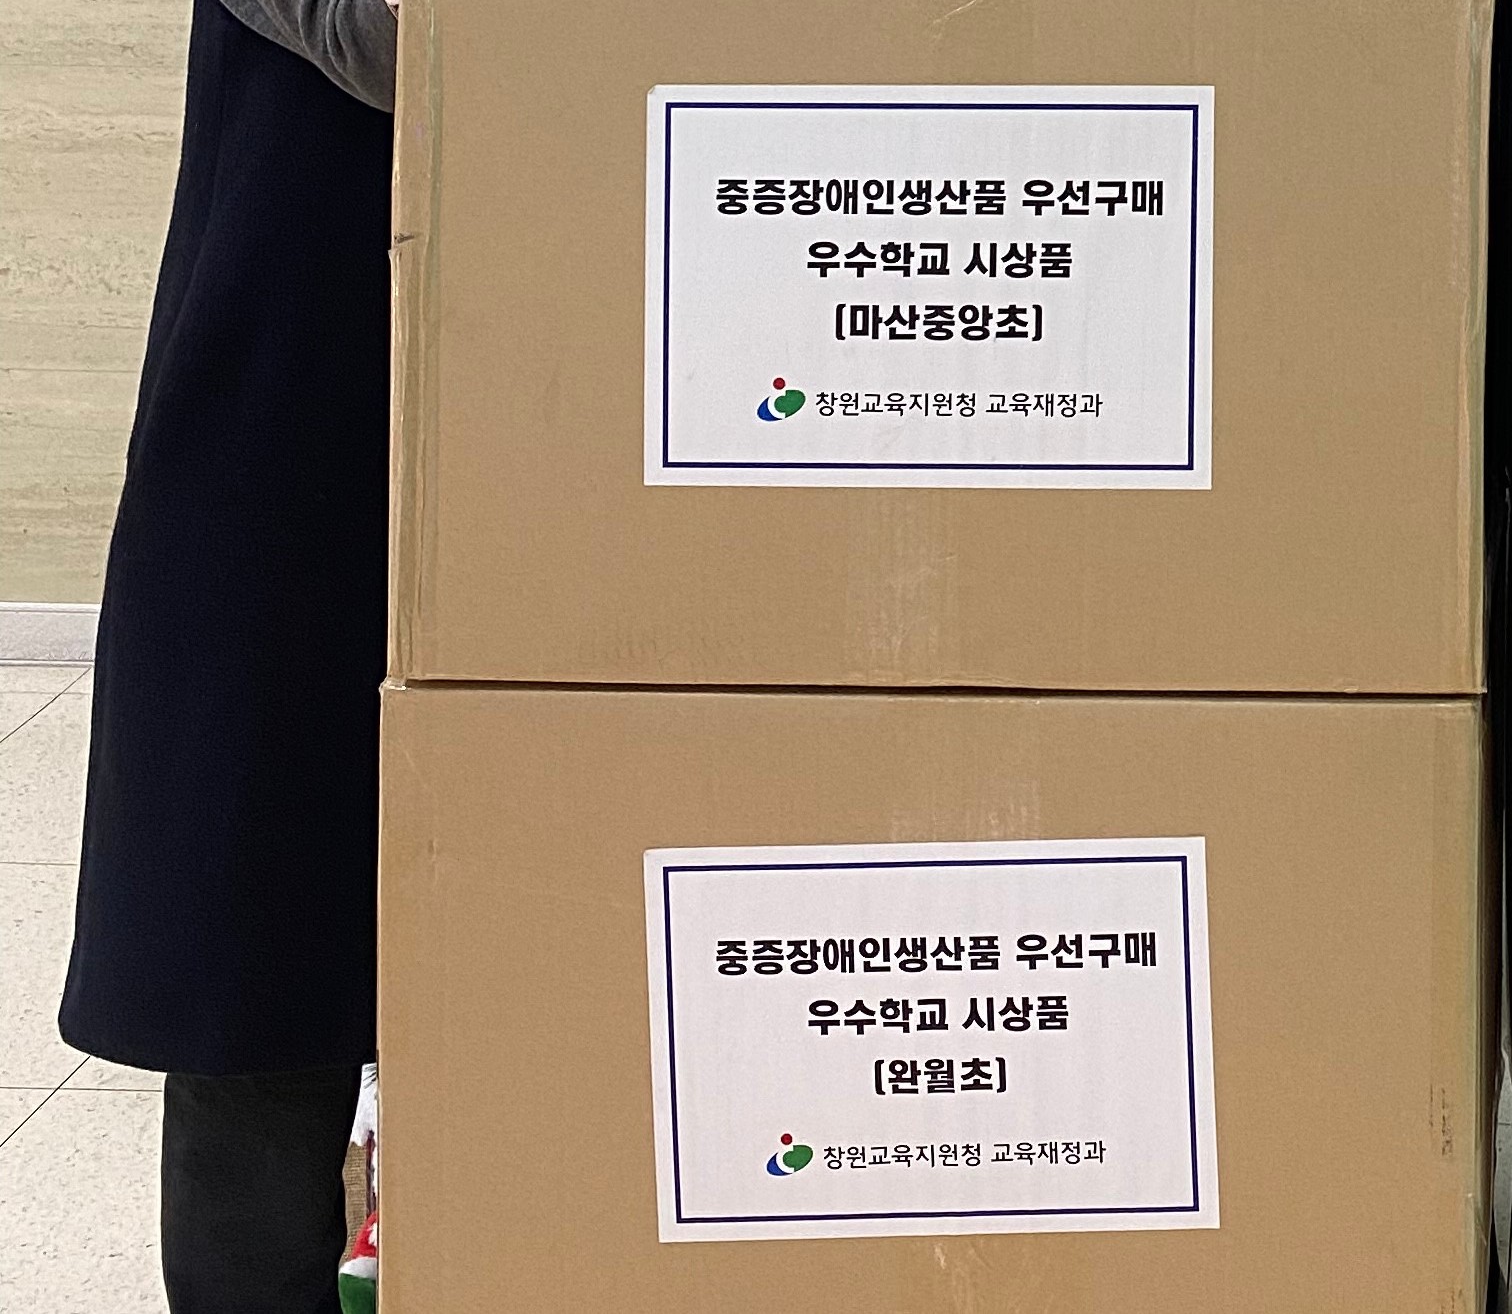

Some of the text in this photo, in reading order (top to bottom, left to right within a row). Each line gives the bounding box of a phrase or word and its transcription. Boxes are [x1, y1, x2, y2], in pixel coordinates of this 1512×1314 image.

[714, 177, 1165, 218] 중증장애인생산품 우선구매
[805, 240, 1074, 280] 우수학교 시상품
[814, 390, 1105, 419] 창원교육지원청 교육재정과
[714, 930, 1158, 977] 중증장애인생산품 우선구매
[806, 994, 1070, 1037] 우수학교 시상품
[822, 1139, 1108, 1171] 창원교육지원청 교육재정과
